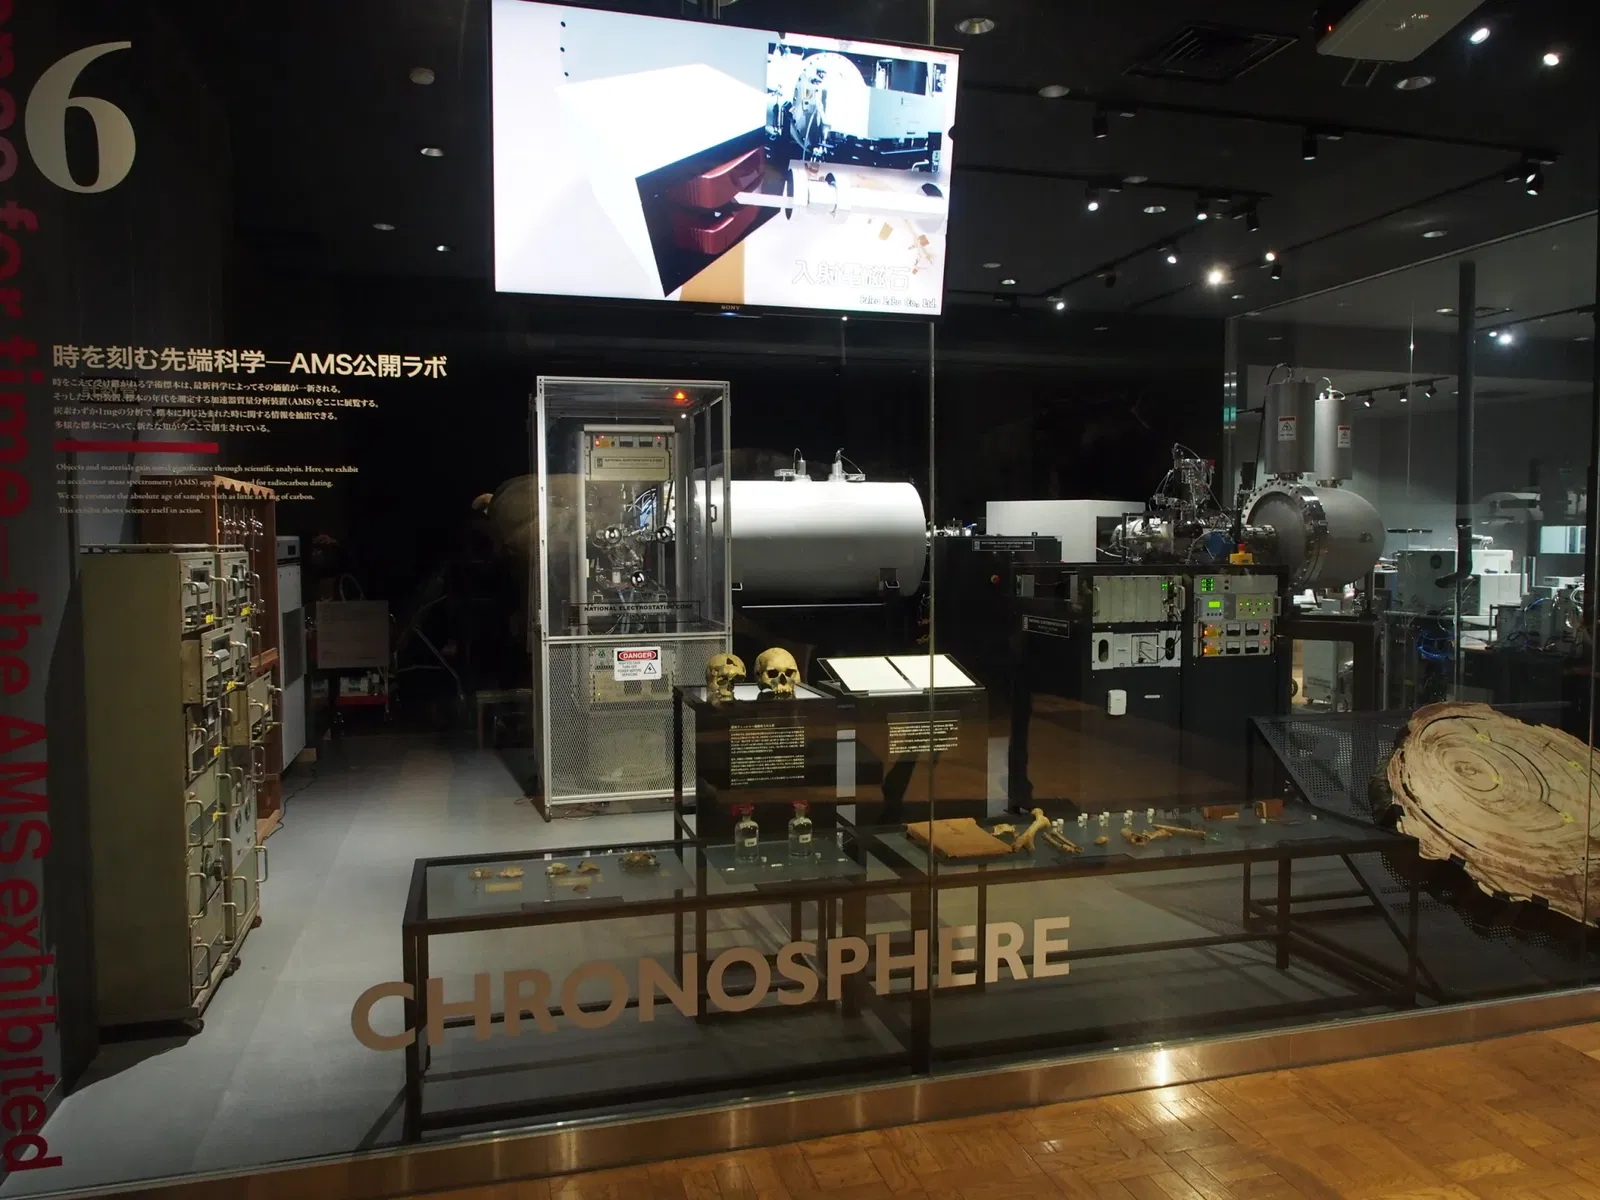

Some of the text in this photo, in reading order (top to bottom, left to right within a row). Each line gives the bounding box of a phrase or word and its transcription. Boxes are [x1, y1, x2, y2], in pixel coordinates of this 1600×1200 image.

[24, 40, 137, 194] 6
[215, 464, 243, 473] through
[275, 465, 304, 474] analysis.
[305, 465, 324, 474] Here,
[335, 465, 359, 473] exhibit
[174, 478, 199, 487] (AMS)
[309, 480, 333, 488] dating.
[130, 492, 160, 500] absolute
[160, 494, 173, 502] age
[174, 492, 183, 500] of
[183, 492, 210, 502] samples
[151, 506, 169, 514] itself
[170, 506, 178, 514] in
[622, 652, 653, 660] DANGER
[0, 714, 53, 862] AMS
[350, 915, 1072, 1052] CHRONOSPHERE
[0, 879, 64, 1172] exhibited
